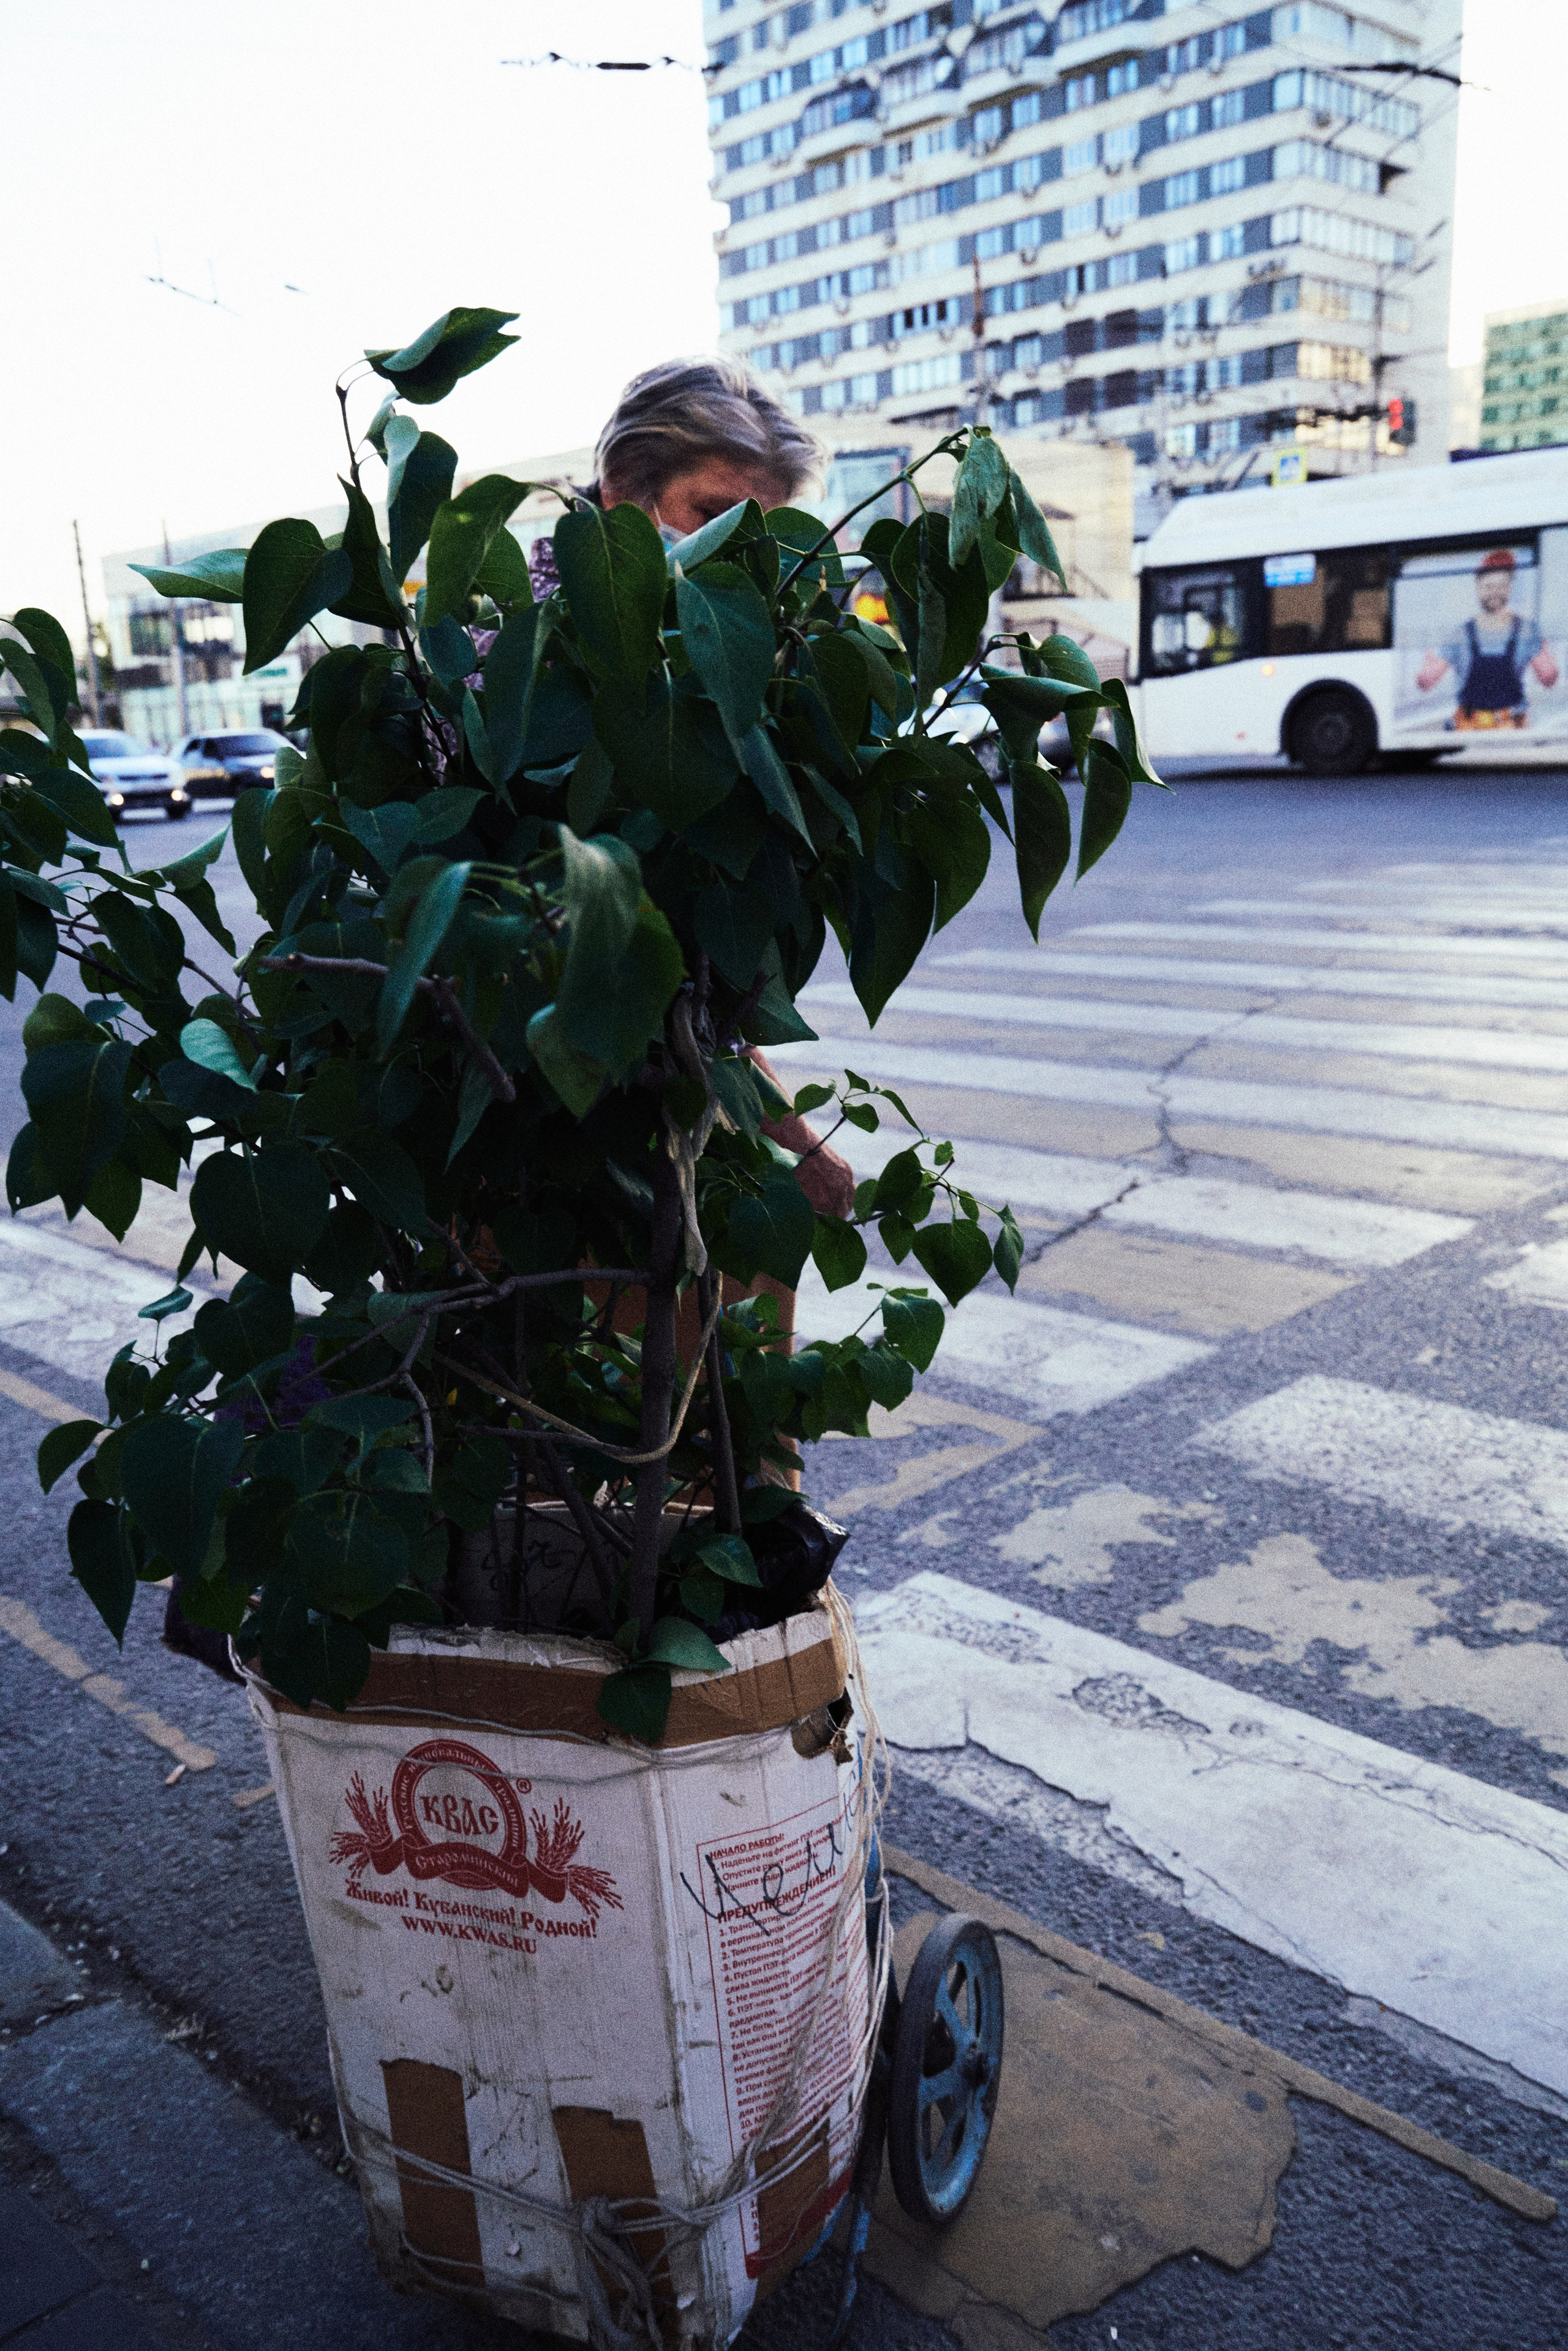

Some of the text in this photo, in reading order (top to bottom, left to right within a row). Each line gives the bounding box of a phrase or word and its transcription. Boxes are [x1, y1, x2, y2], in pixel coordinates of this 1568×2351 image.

[420, 1794, 499, 1836] КВАС
[710, 1843, 747, 1859] НАЧАЛО
[721, 1854, 761, 1869] Наденьте
[722, 1865, 761, 1881] Опустите
[344, 1879, 597, 1938] Живой! Кубанский! Родной!
[401, 1915, 537, 1955] WWW.KWAS.RU
[731, 1937, 784, 1957] Температура
[734, 1967, 762, 1980] Пустая
[736, 1994, 748, 2002] Не
[745, 2083, 763, 2093] При
